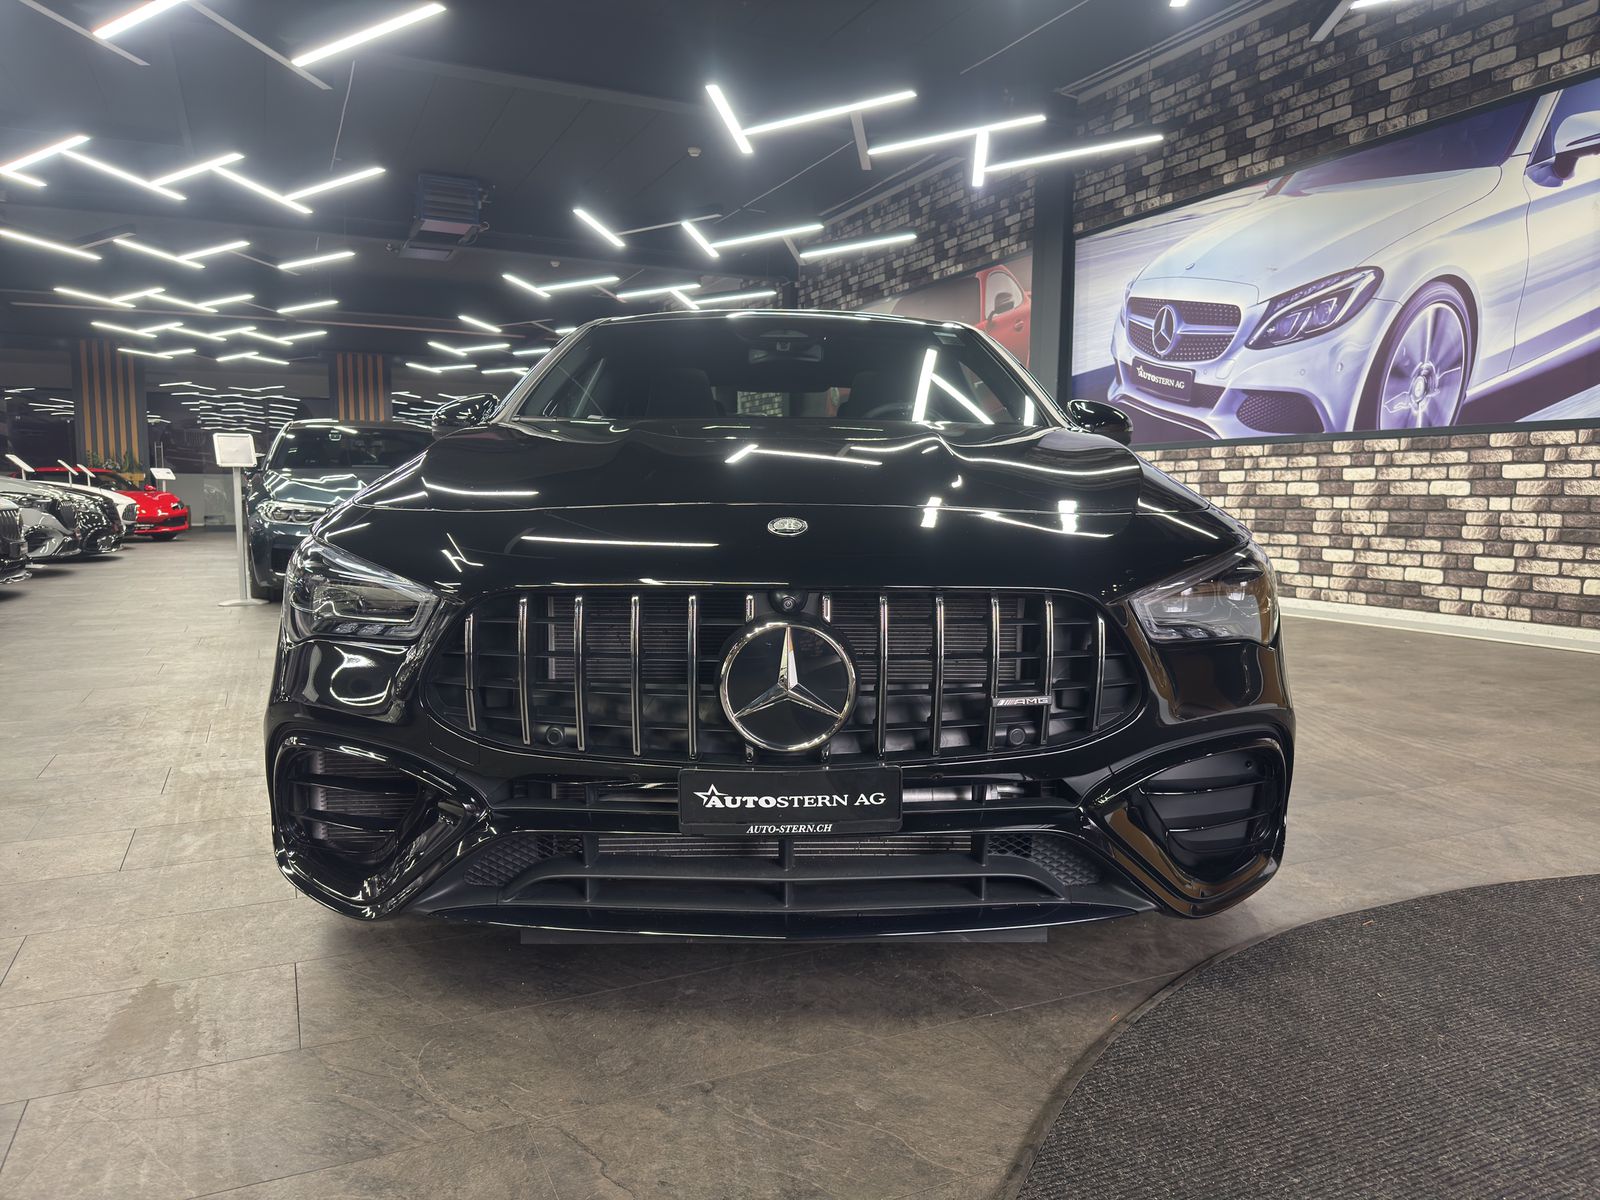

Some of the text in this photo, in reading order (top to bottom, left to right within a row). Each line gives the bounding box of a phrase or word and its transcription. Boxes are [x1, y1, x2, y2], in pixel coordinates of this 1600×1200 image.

[1138, 369, 1185, 389] AUTOSTERN AG
[703, 792, 886, 808] AUTOSTERN AG
[746, 824, 833, 834] AUTO-STERN.CH
